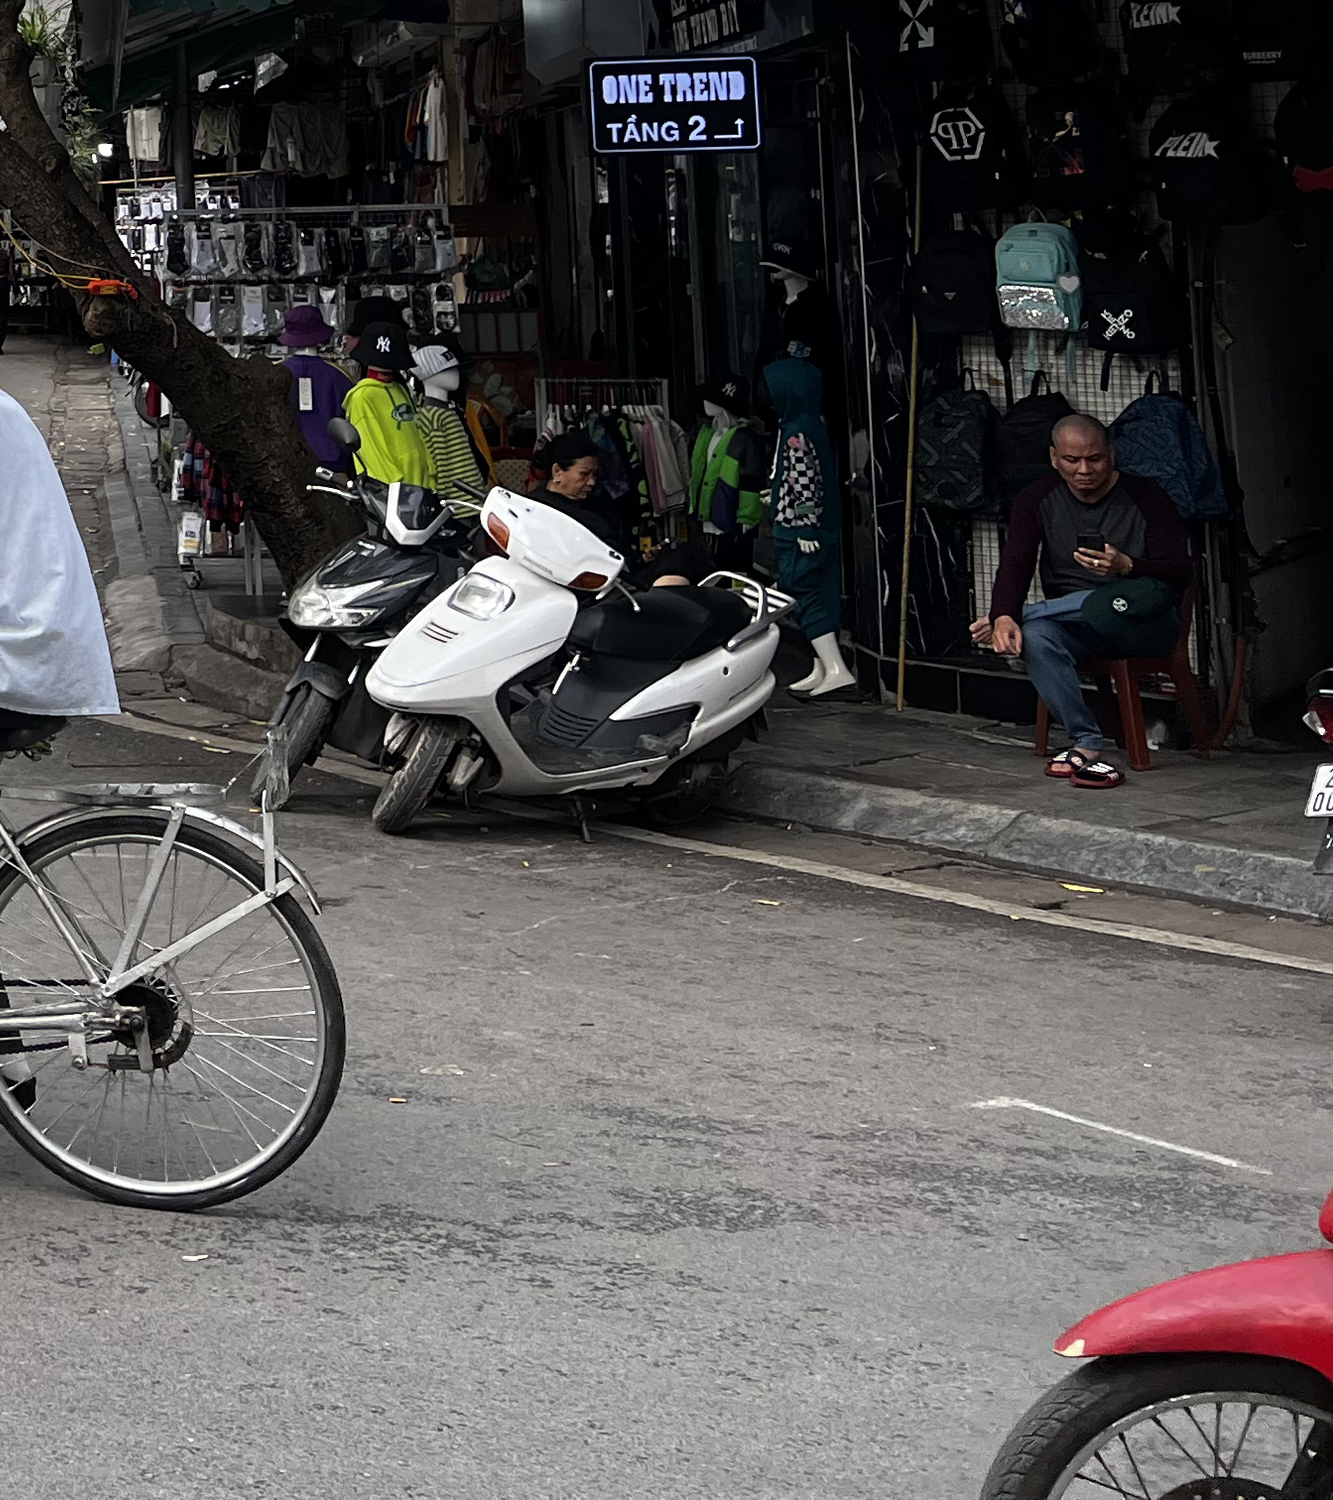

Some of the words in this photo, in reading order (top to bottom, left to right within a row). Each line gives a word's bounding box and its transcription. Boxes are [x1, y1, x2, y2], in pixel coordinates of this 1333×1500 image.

[602, 73, 654, 104] ONE
[659, 70, 746, 103] TREND
[606, 113, 680, 143] TẦNG
[688, 114, 707, 141] 2
